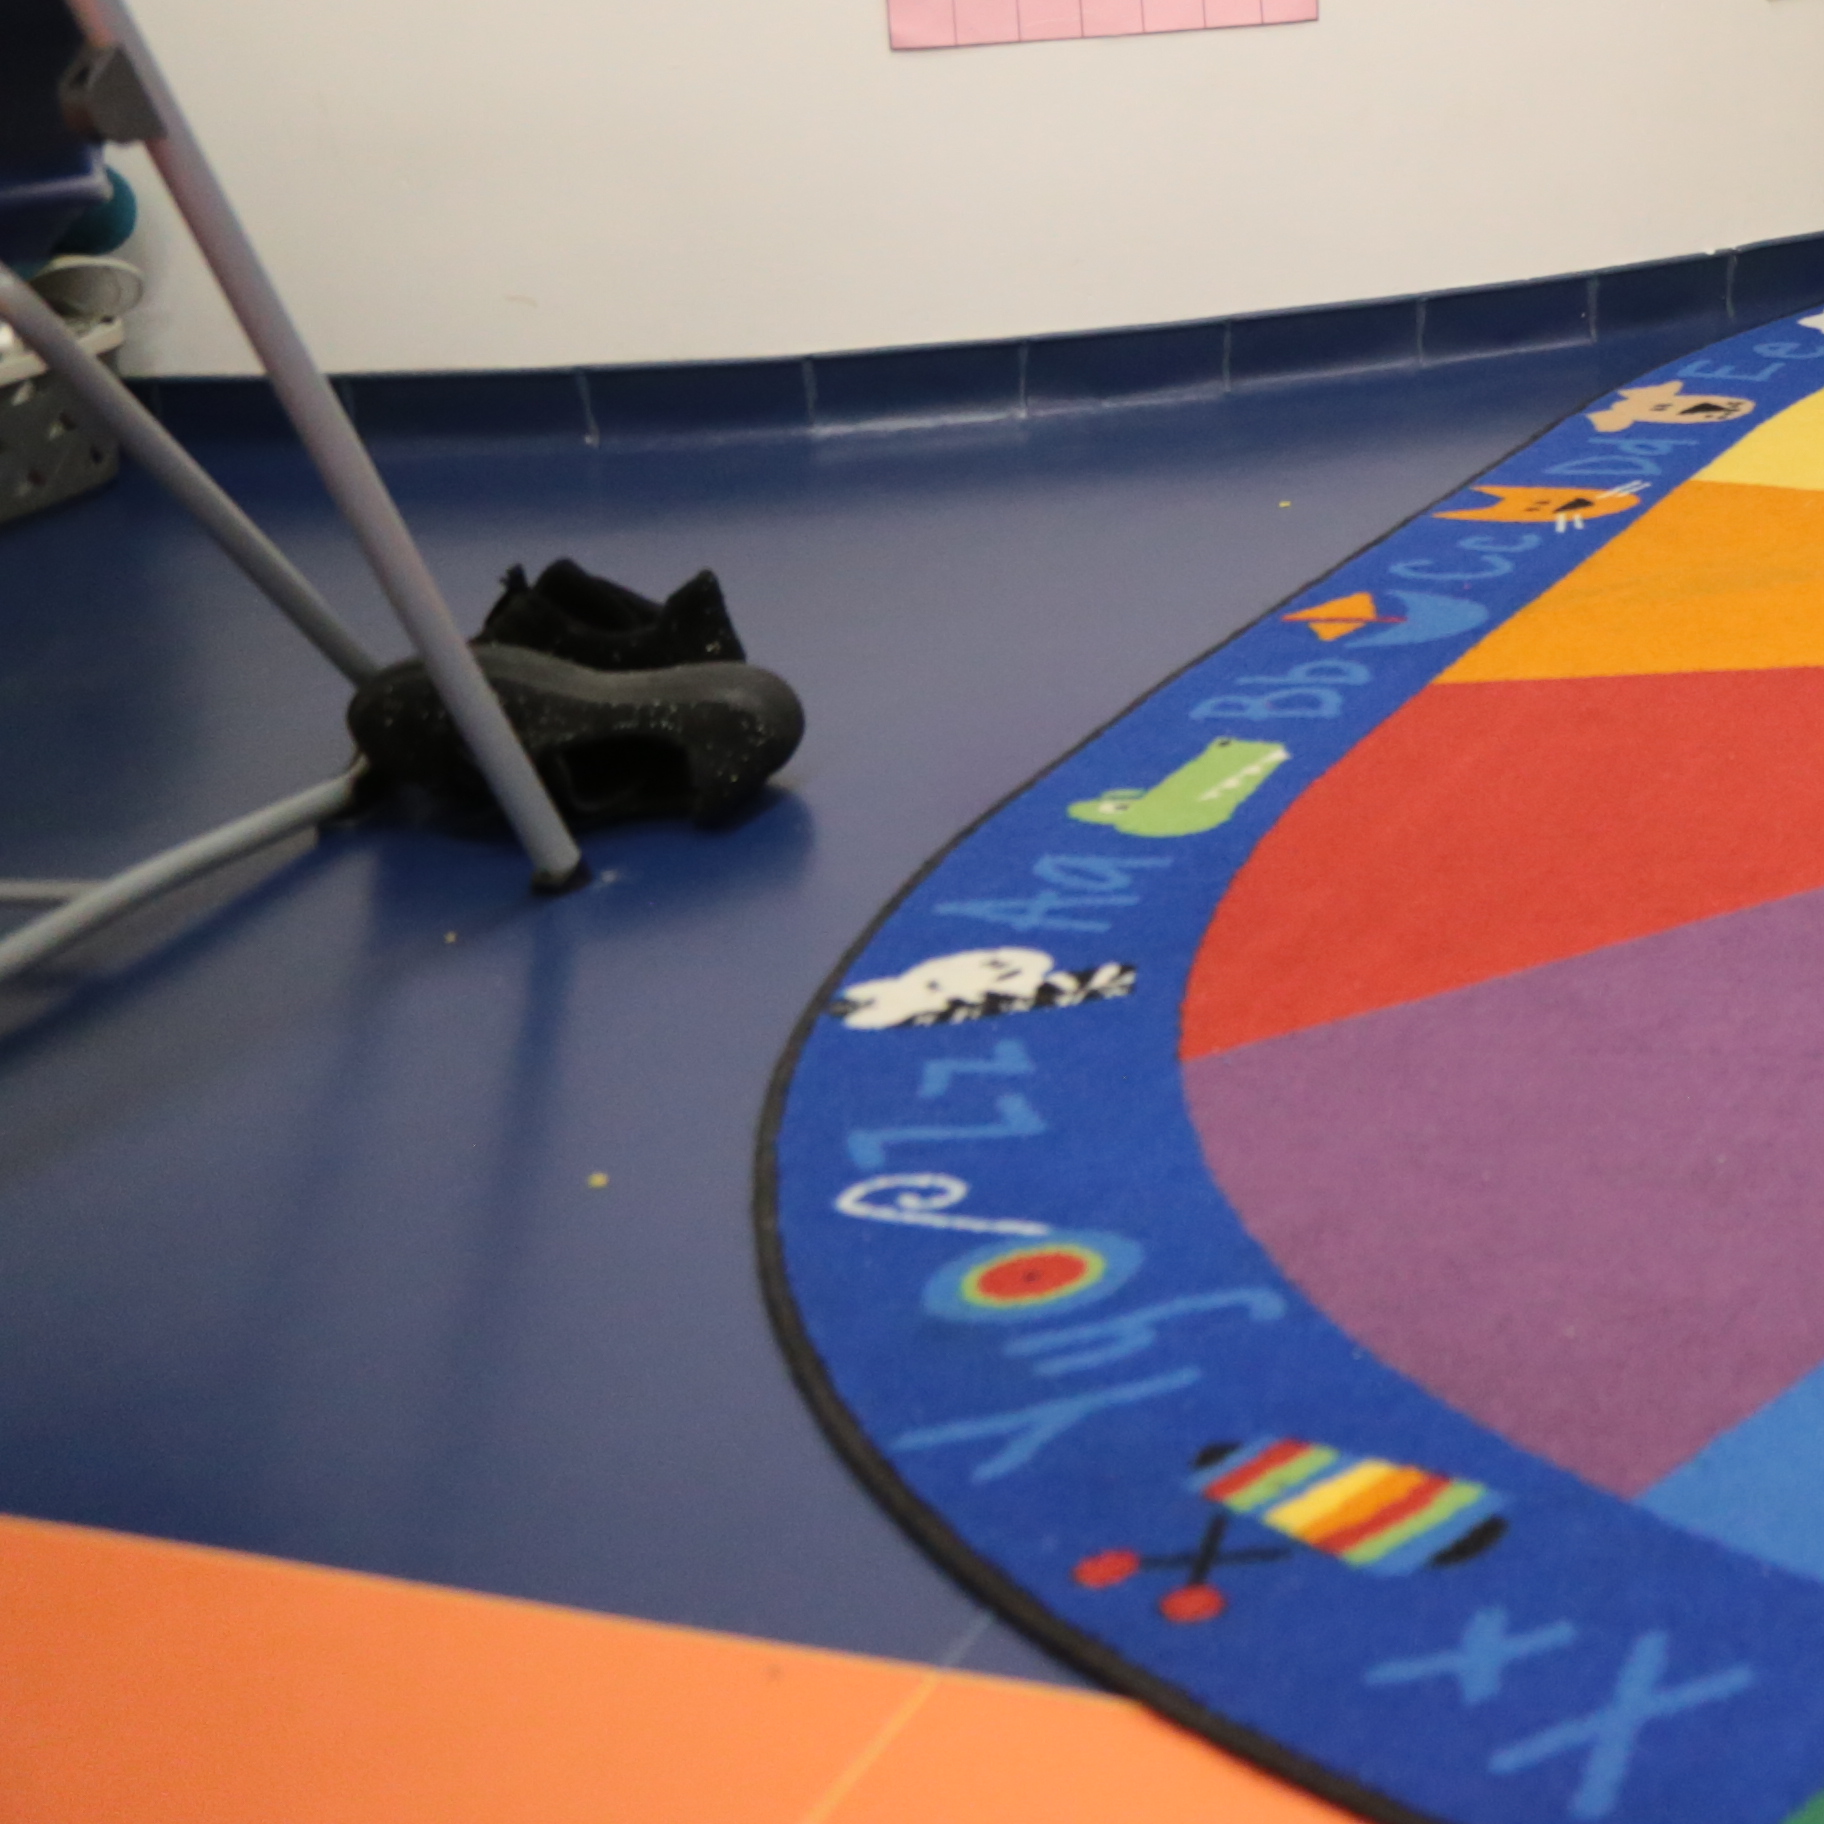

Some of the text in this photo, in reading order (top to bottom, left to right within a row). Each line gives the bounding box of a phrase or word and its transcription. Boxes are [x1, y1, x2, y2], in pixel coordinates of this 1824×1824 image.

[1545, 436, 1699, 475] Dd
[1390, 533, 1541, 580] Cc
[1189, 659, 1370, 720] Bb
[846, 1038, 1047, 1168] Zz
[1364, 1606, 1754, 1818] Xx
